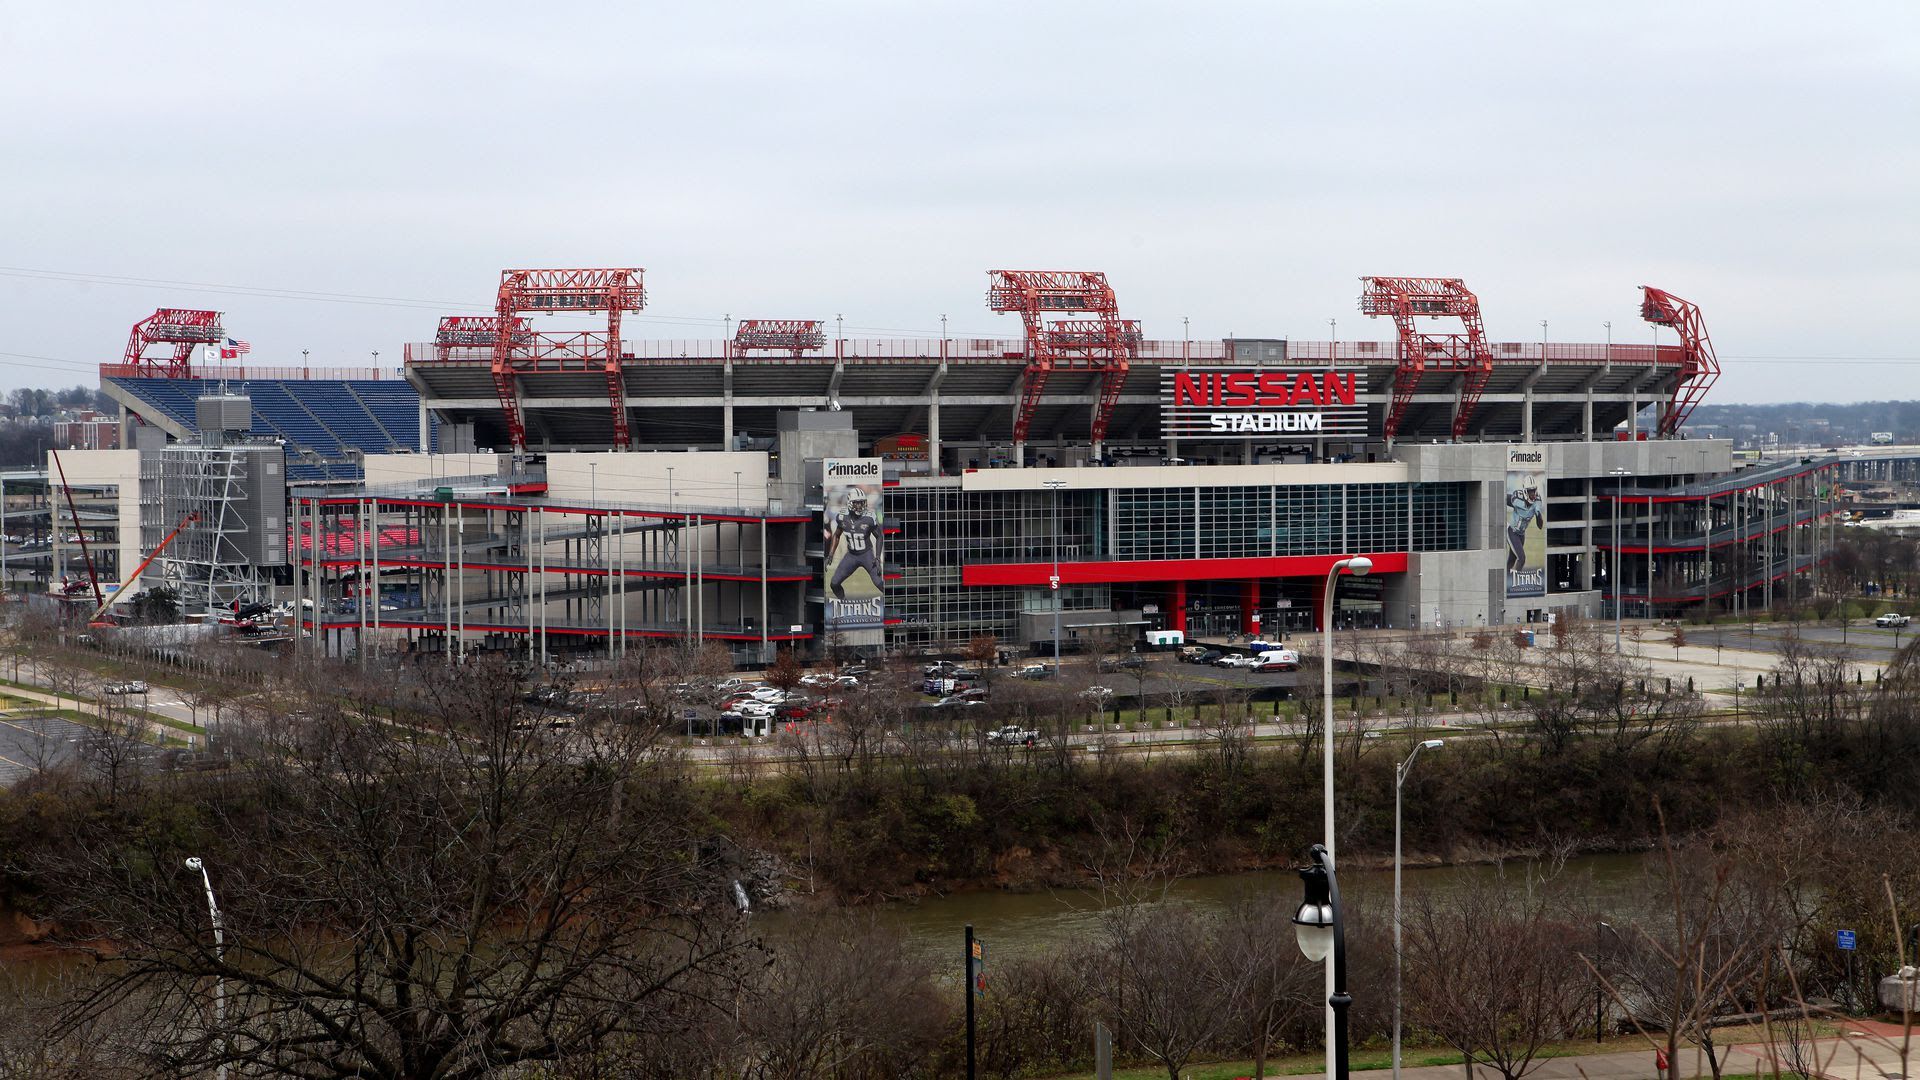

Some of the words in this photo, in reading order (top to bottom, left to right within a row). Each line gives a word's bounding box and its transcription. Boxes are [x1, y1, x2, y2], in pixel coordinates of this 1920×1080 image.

[1174, 372, 1356, 406] NISSAN
[1210, 413, 1322, 432] STADIUM
[1510, 450, 1542, 463] Pinnacle
[828, 461, 879, 476] Pinnacle
[1051, 581, 1058, 589] S
[1510, 568, 1542, 588] TITANS
[829, 596, 881, 619] TITANS
